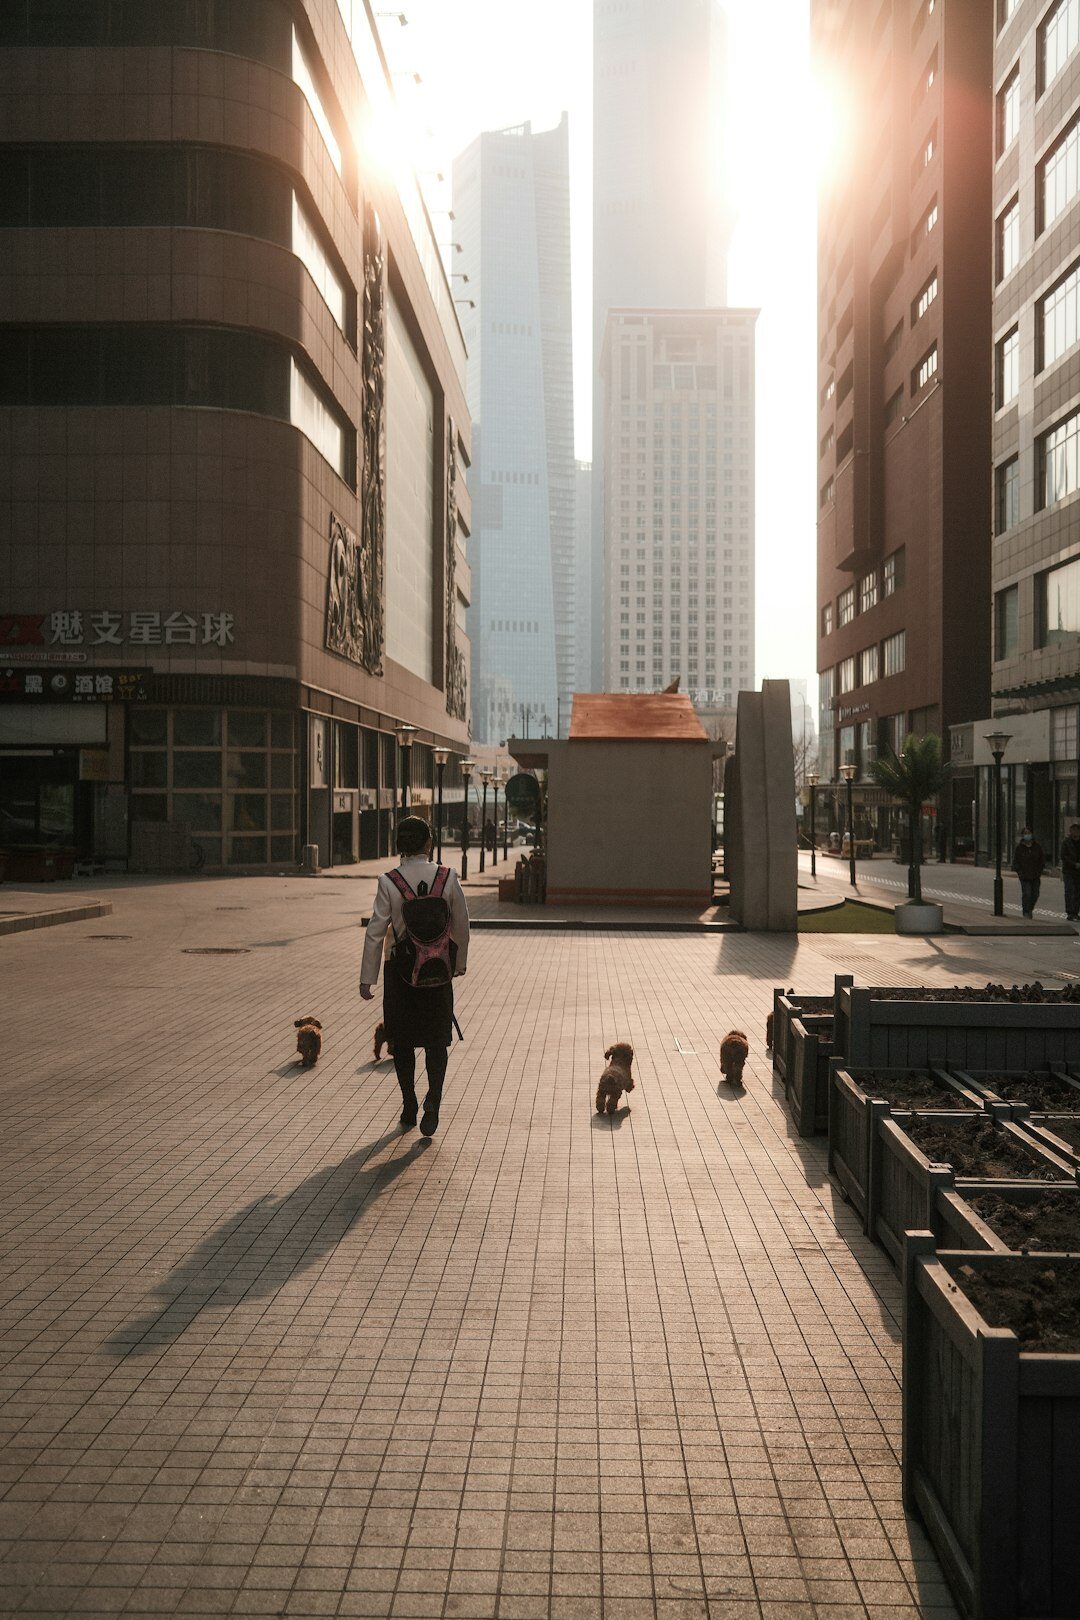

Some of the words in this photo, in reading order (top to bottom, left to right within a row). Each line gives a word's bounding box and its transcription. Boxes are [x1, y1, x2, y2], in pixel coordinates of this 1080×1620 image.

[50, 610, 235, 646] 魅支星台球
